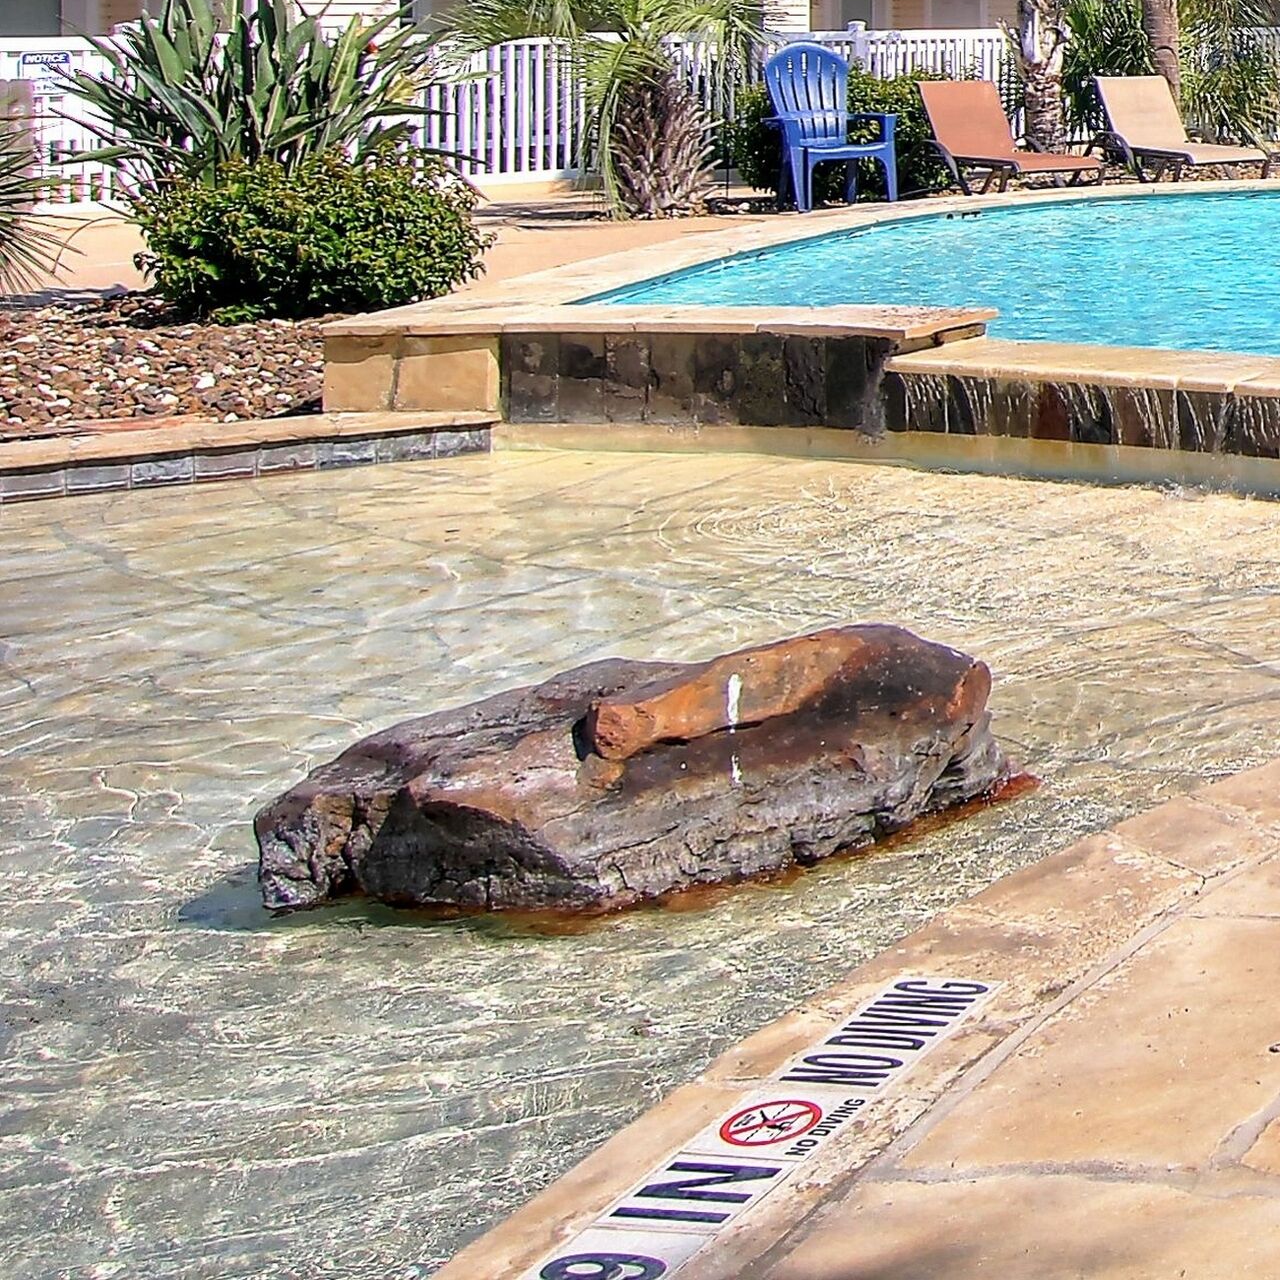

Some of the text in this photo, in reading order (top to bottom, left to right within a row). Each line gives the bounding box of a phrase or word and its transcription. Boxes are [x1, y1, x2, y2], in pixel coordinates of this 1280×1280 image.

[25, 53, 67, 64] NOTICE
[779, 980, 989, 1087] NO DIVING
[784, 1098, 866, 1156] NO DIVING
[609, 1161, 783, 1224] IN
